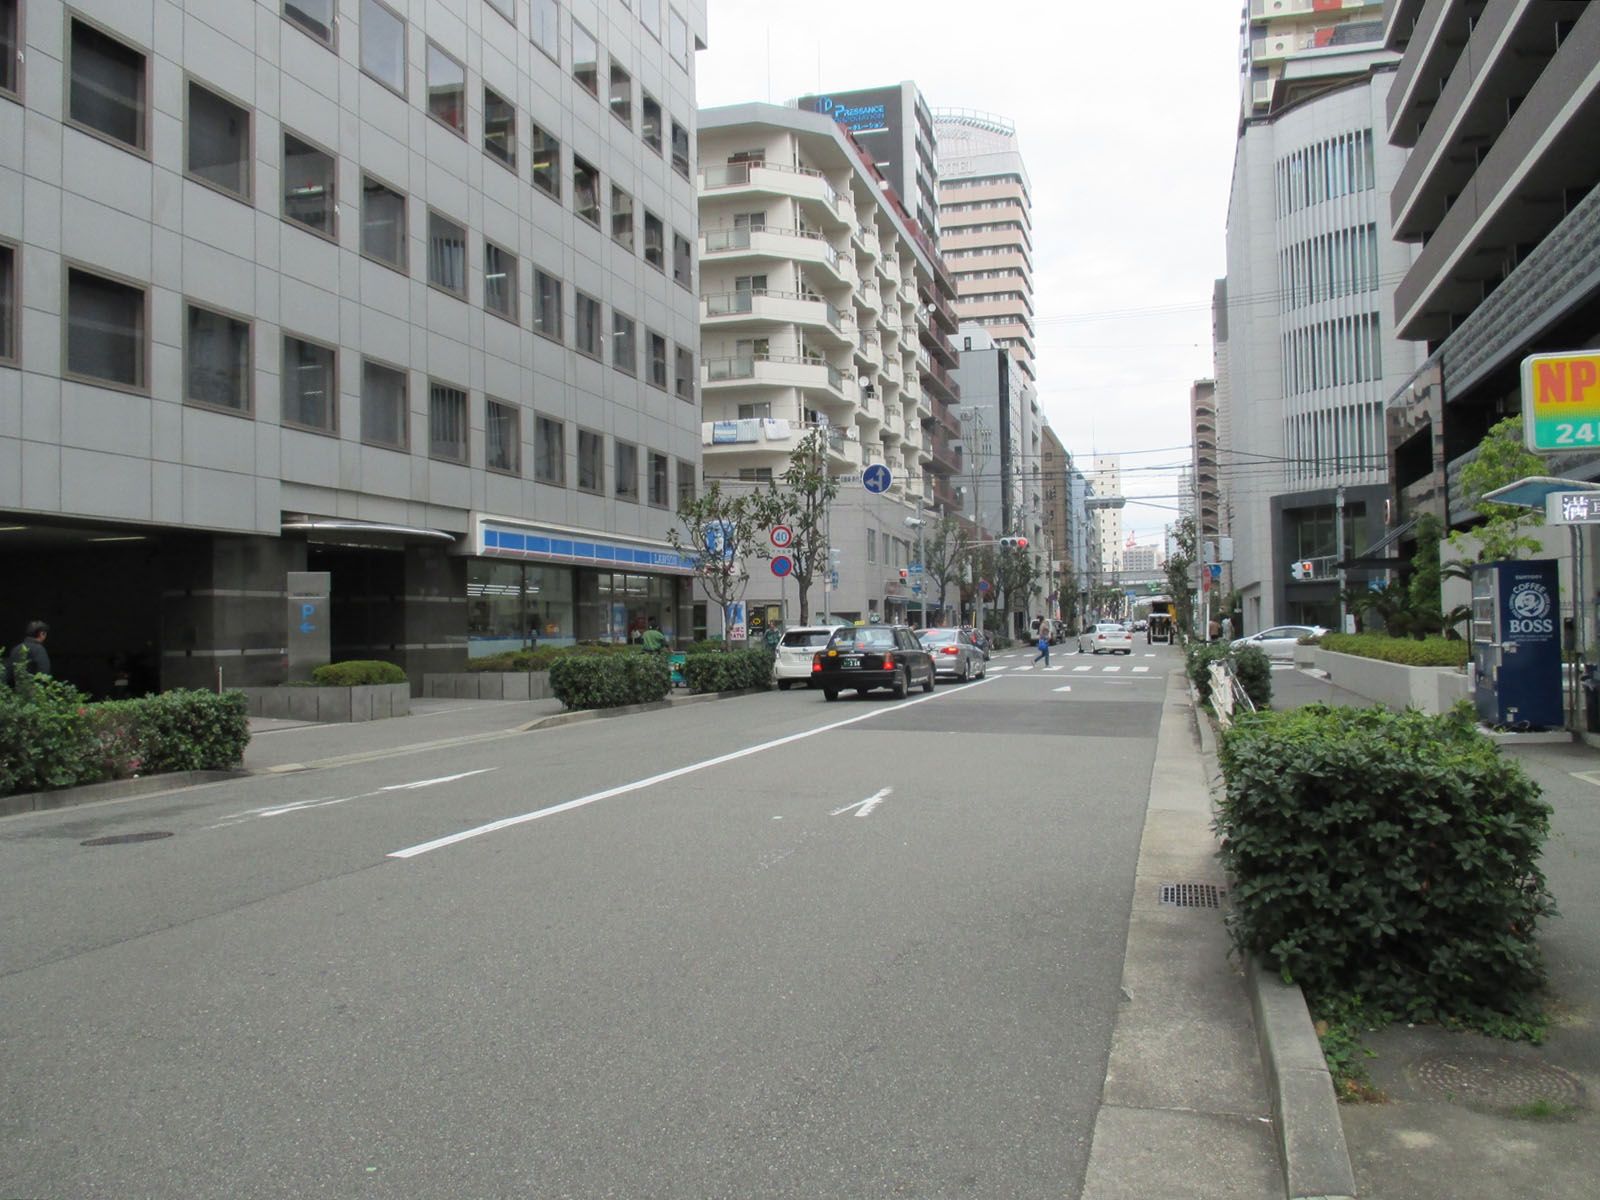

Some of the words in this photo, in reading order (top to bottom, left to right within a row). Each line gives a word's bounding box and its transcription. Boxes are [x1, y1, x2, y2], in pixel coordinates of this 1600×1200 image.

[1538, 361, 1597, 403] NP
[1556, 422, 1600, 444] 24
[1563, 496, 1589, 520] 満
[775, 531, 787, 541] 40
[1512, 582, 1547, 594] COFFEE
[302, 604, 315, 619] P
[1509, 619, 1553, 633] BOSS
